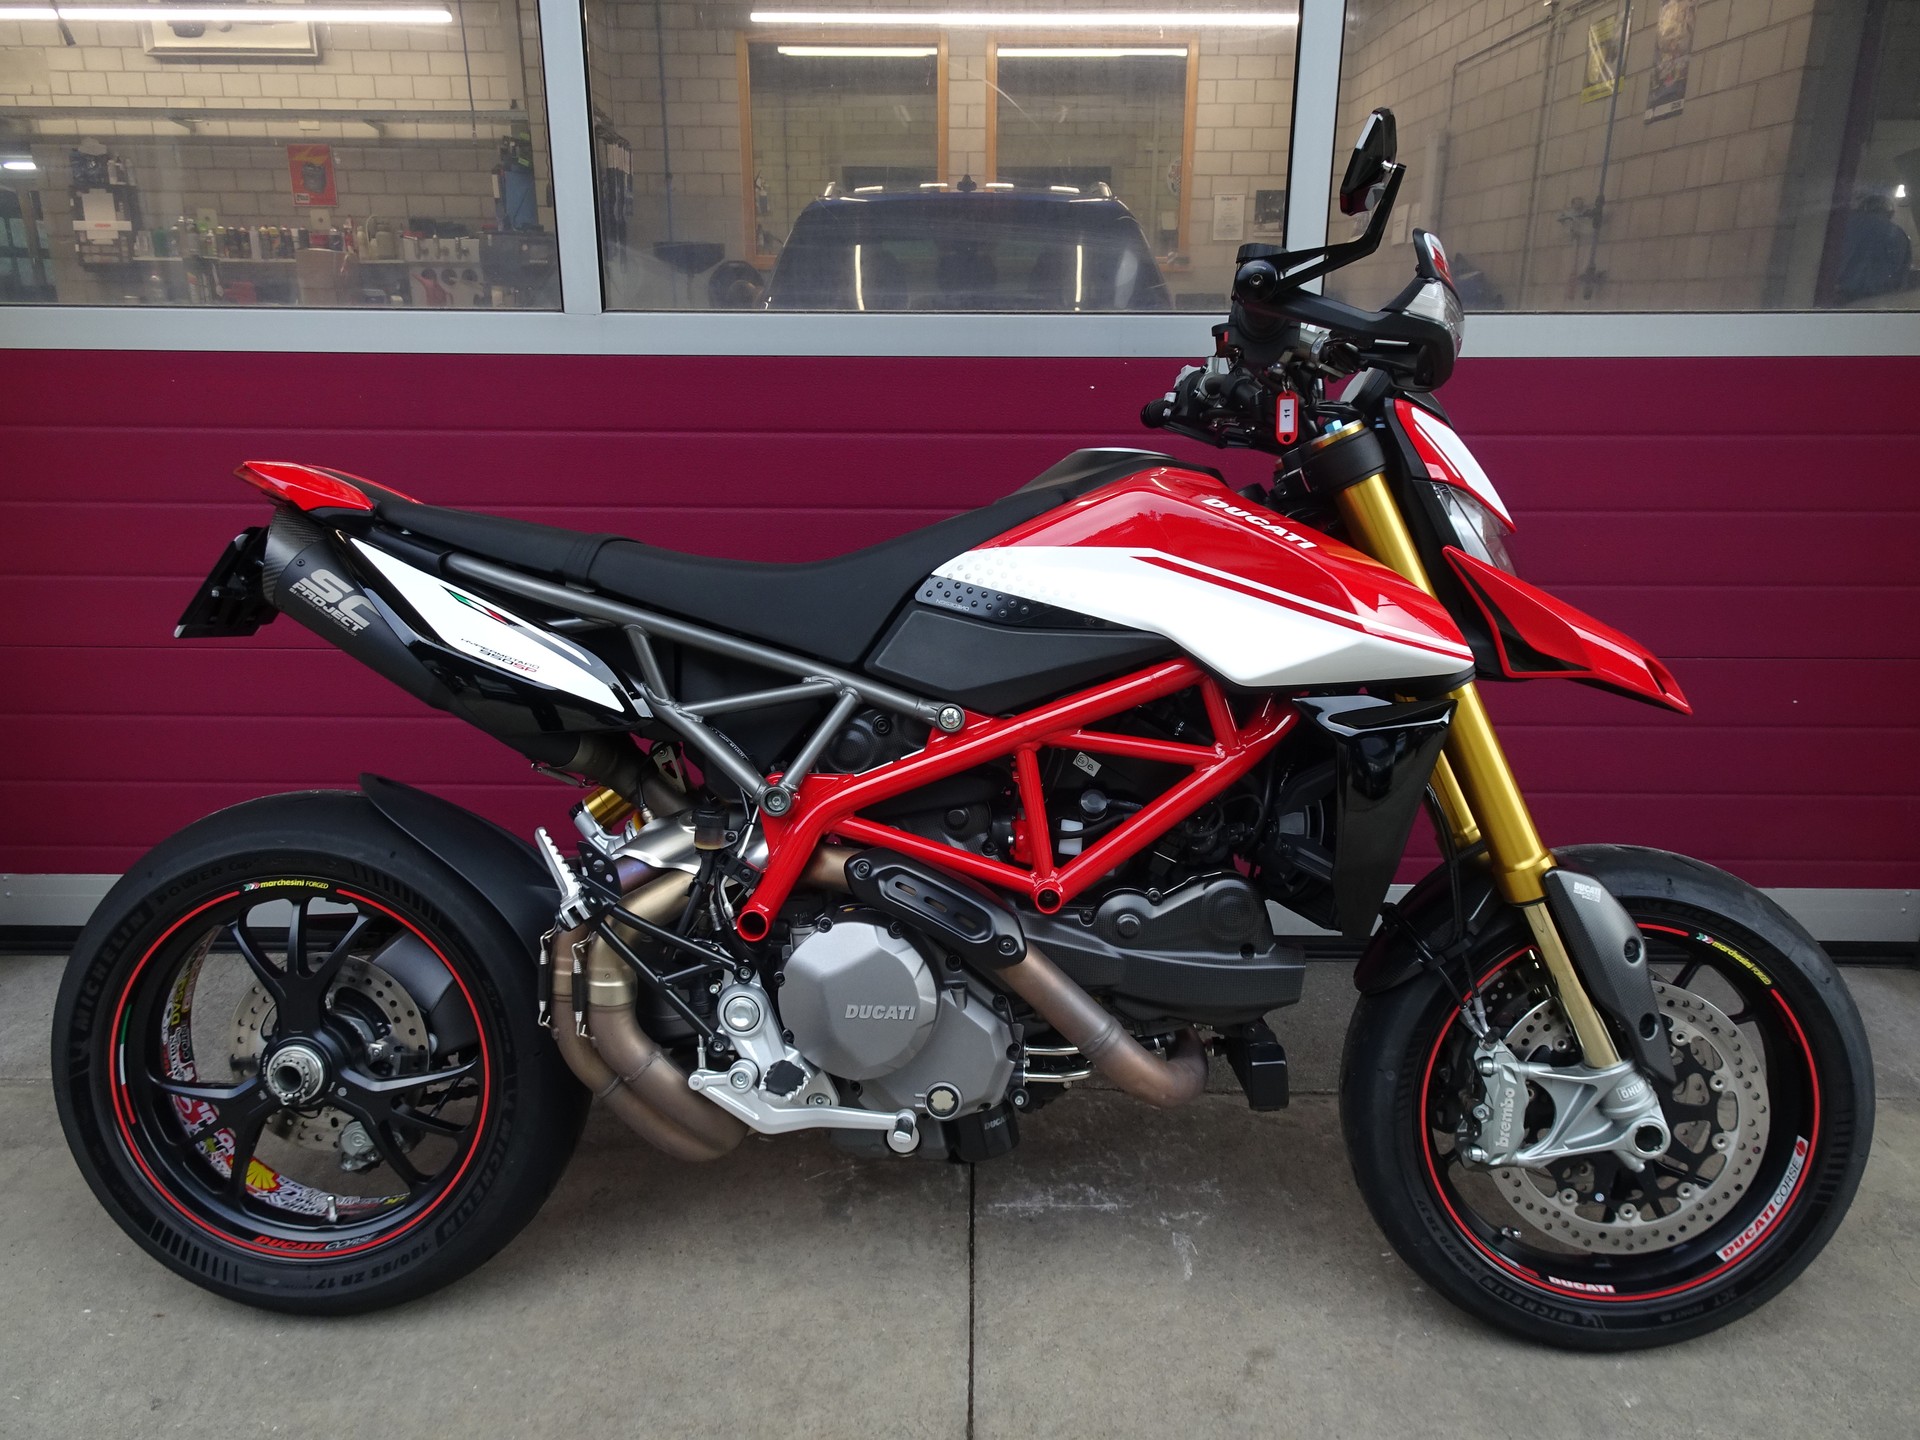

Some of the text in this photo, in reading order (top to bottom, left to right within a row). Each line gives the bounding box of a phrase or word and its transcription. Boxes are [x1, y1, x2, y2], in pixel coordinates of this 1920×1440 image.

[1284, 408, 1290, 418] 11
[1201, 498, 1317, 549] DUCATI
[292, 582, 364, 632] PROJECT
[299, 568, 382, 628] SC
[155, 865, 223, 904] POWER
[260, 879, 329, 890] marchesini FORGED
[1573, 881, 1602, 896] DUCATI
[73, 911, 147, 1032] MICHELIN
[1711, 940, 1756, 970] marchesini
[844, 1003, 917, 1021] DUCATI
[1495, 1087, 1515, 1148] brembo
[441, 1118, 513, 1242] MICHELIN
[1721, 1157, 1802, 1259] DUCATI CORSE
[253, 1235, 328, 1251] DUCATI
[1482, 1276, 1577, 1324] MICHELIN
[1548, 1275, 1617, 1294] DUCATI
